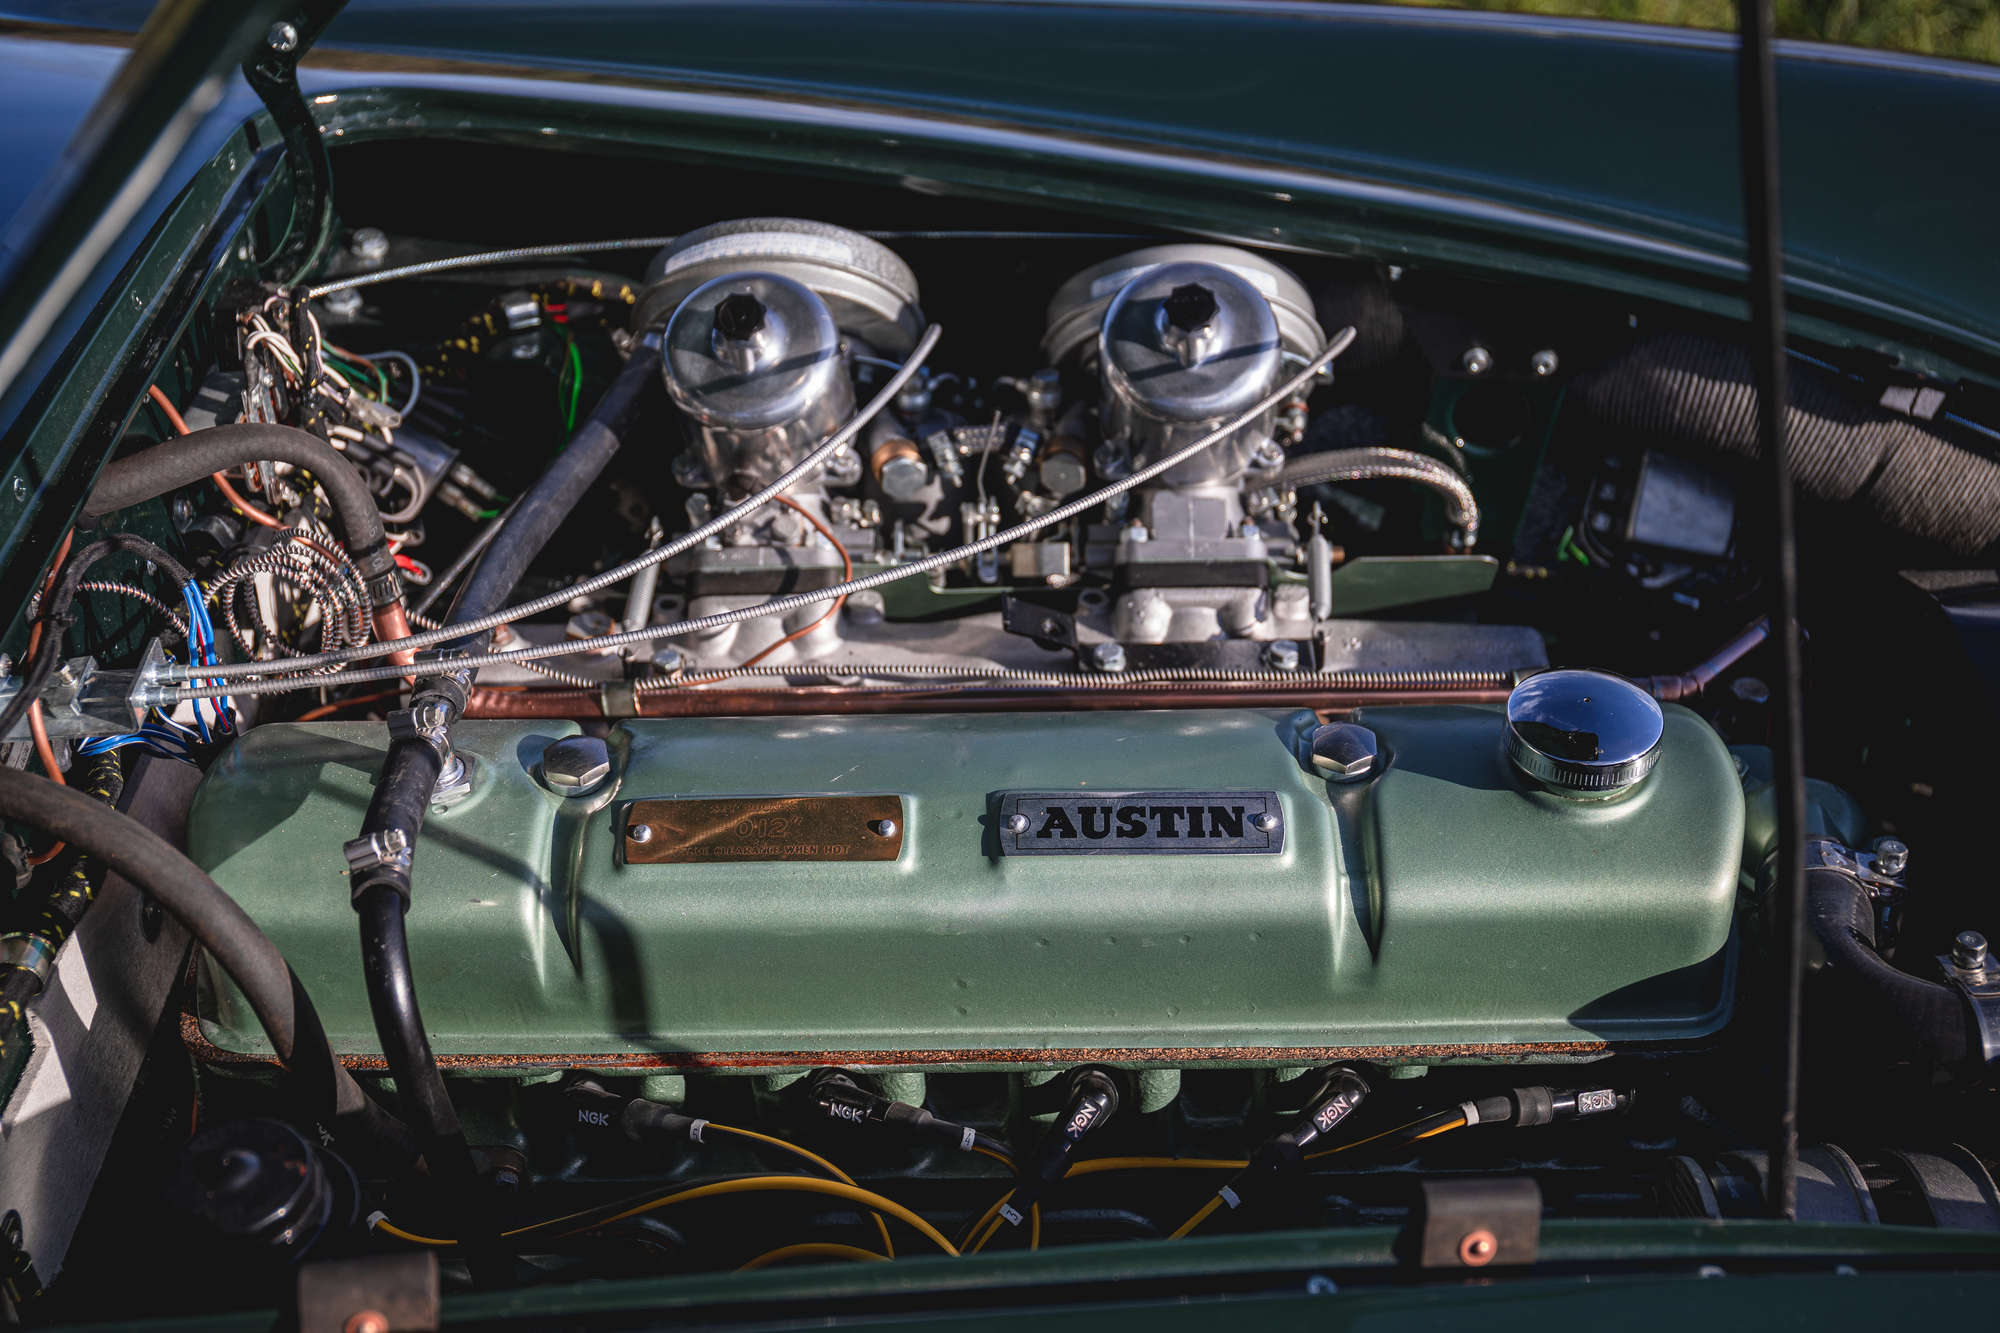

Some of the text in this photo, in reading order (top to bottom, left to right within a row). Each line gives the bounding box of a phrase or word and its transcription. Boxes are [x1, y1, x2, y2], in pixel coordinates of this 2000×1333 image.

[1036, 806, 1245, 839] AUSTIN
[823, 843, 850, 855] HOT
[829, 1101, 864, 1124] NGK
[1317, 1096, 1349, 1128] NGK
[1580, 1091, 1613, 1112] NGK
[578, 1109, 609, 1126] NGK
[1067, 1102, 1097, 1138] NGK
